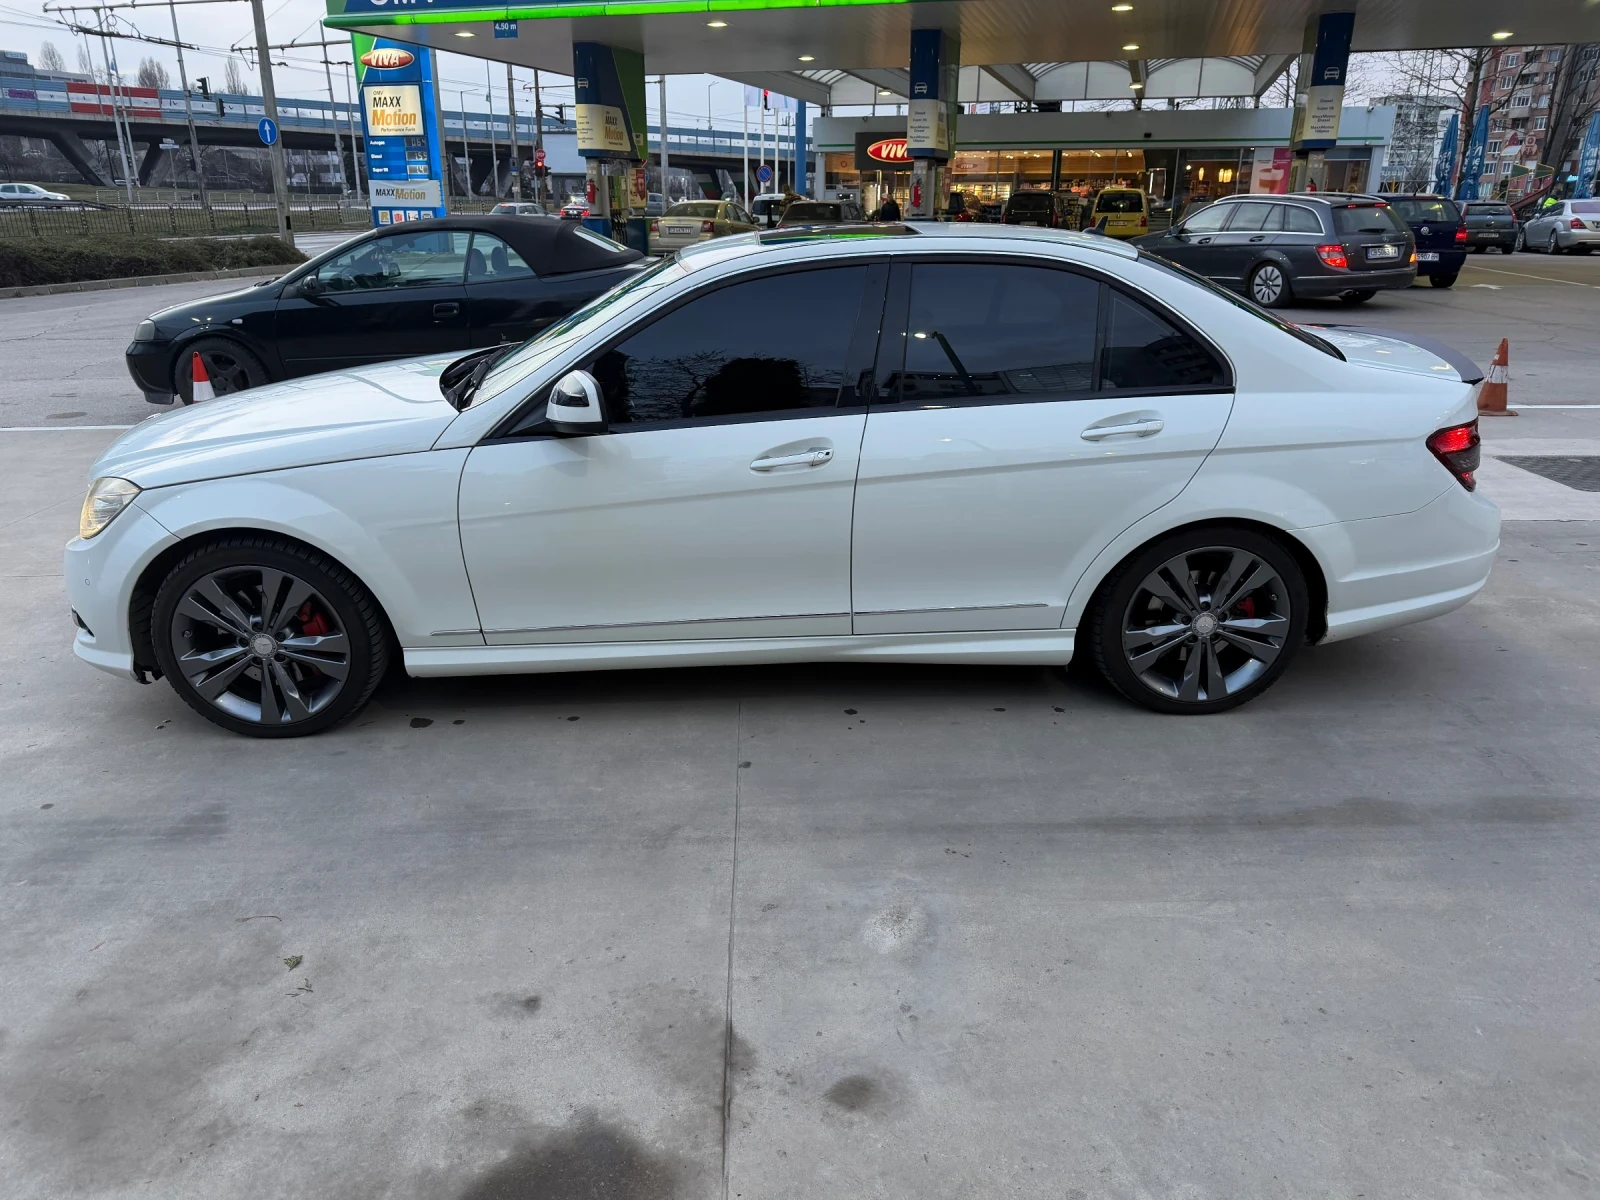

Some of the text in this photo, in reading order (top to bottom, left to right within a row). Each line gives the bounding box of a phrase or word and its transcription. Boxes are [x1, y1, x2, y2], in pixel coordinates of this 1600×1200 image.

[495, 22, 509, 30] 4.50
[371, 53, 400, 67] VIVA
[372, 96, 402, 108] MAXX
[372, 109, 417, 126] Motion
[881, 143, 908, 158] VIV
